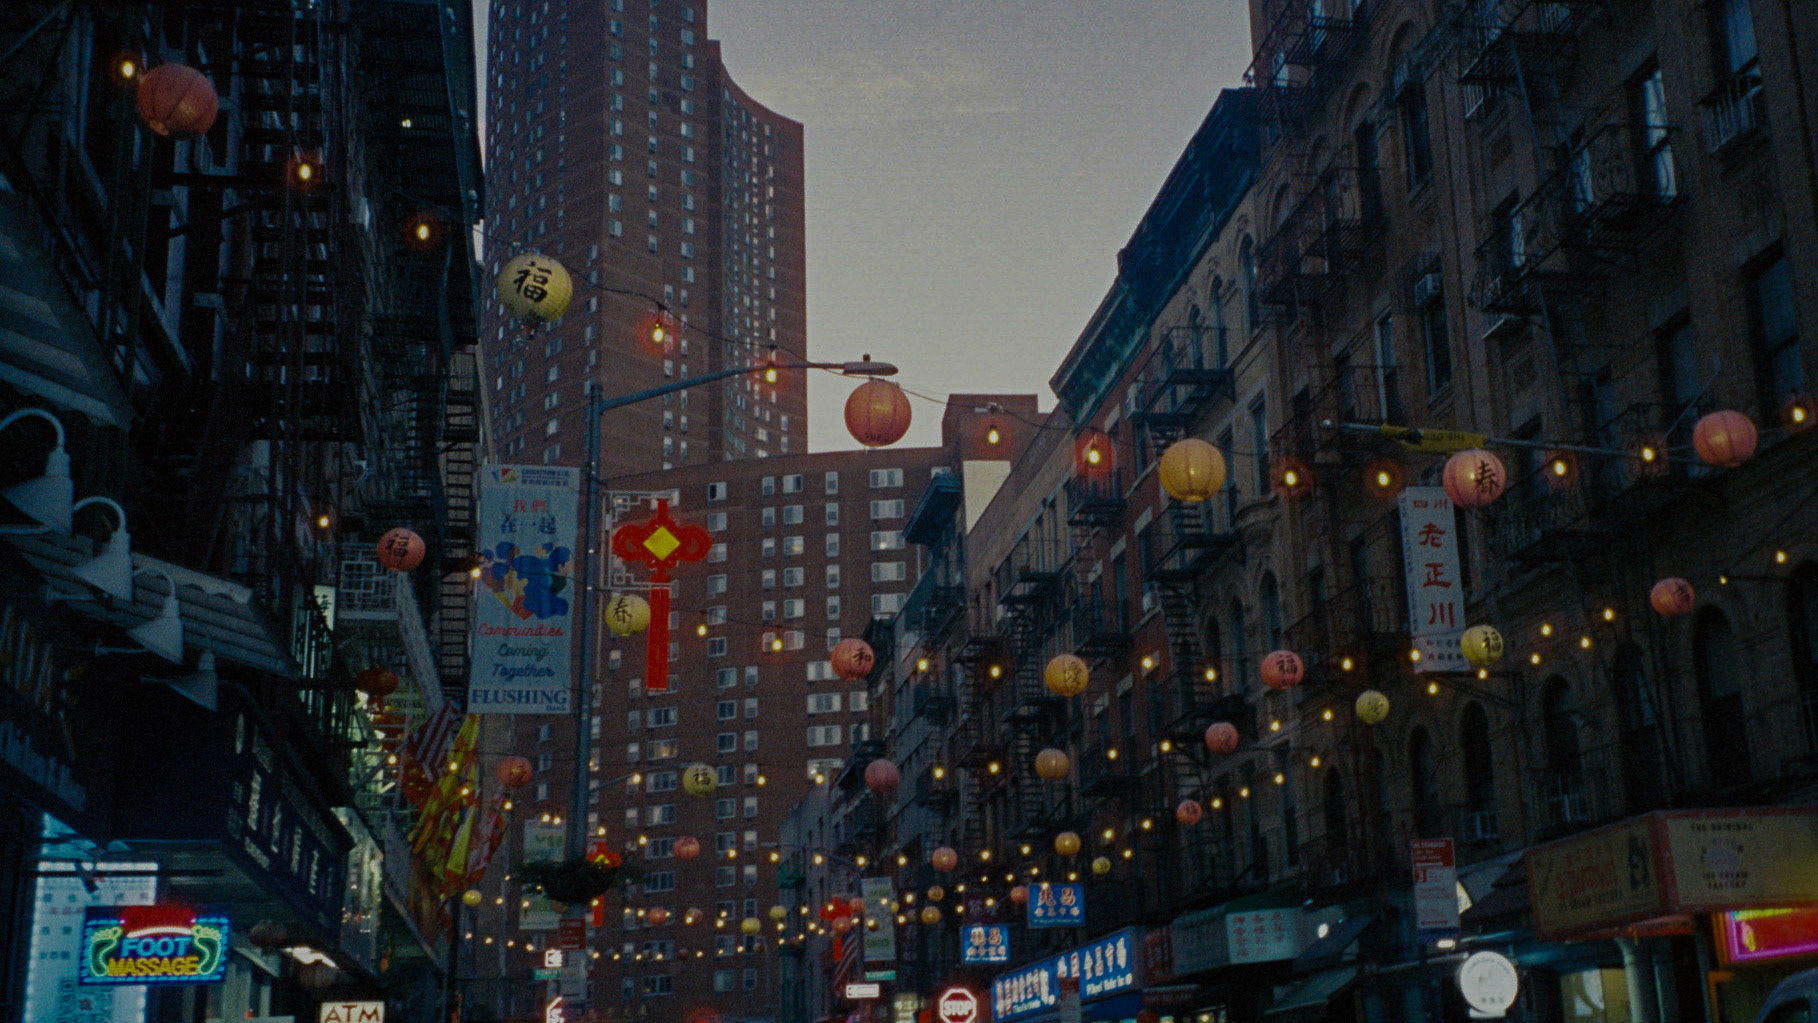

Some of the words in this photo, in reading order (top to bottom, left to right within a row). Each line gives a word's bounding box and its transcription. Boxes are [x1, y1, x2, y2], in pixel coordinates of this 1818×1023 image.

[513, 261, 552, 302] 福
[1475, 460, 1499, 494] 春
[512, 499, 546, 513] 我們
[387, 533, 409, 557] 福
[1418, 522, 1455, 628] 老正川
[613, 598, 632, 624] 春
[477, 622, 565, 637] Communities
[1483, 630, 1502, 653] 福
[498, 643, 550, 662] Coming
[852, 647, 872, 665] 和
[492, 663, 555, 681] Together
[1276, 654, 1297, 674] 福
[471, 689, 568, 704] FLUSHING
[121, 937, 191, 957] FOOT
[107, 956, 199, 977] MASSAGE
[323, 1004, 380, 1023] ATM
[943, 1000, 972, 1016] STOP
